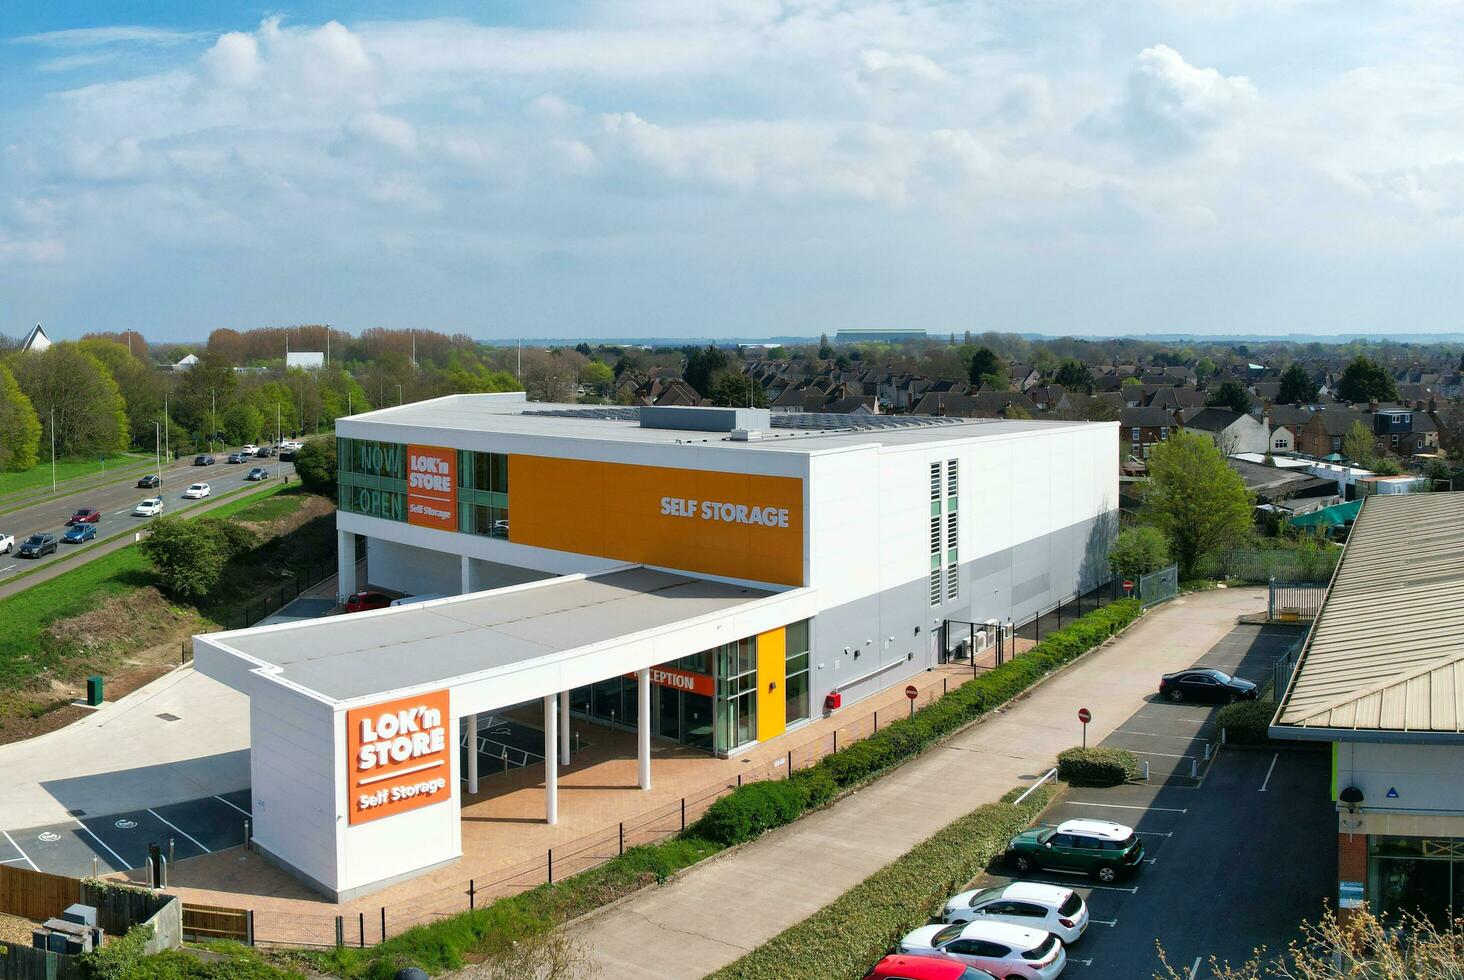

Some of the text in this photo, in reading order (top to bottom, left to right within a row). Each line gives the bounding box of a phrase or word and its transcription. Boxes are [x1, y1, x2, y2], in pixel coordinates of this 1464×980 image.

[360, 446, 401, 473] NOW
[410, 455, 449, 474] LOK'n
[409, 472, 451, 492] STORE
[359, 489, 402, 521] OPEN
[409, 503, 451, 520] Self Storage
[660, 496, 789, 528] SELF STORAGE
[634, 669, 695, 690] EPTION
[360, 705, 441, 743] LOK'n
[358, 727, 445, 770] STORE
[358, 778, 446, 809] Self Storage
